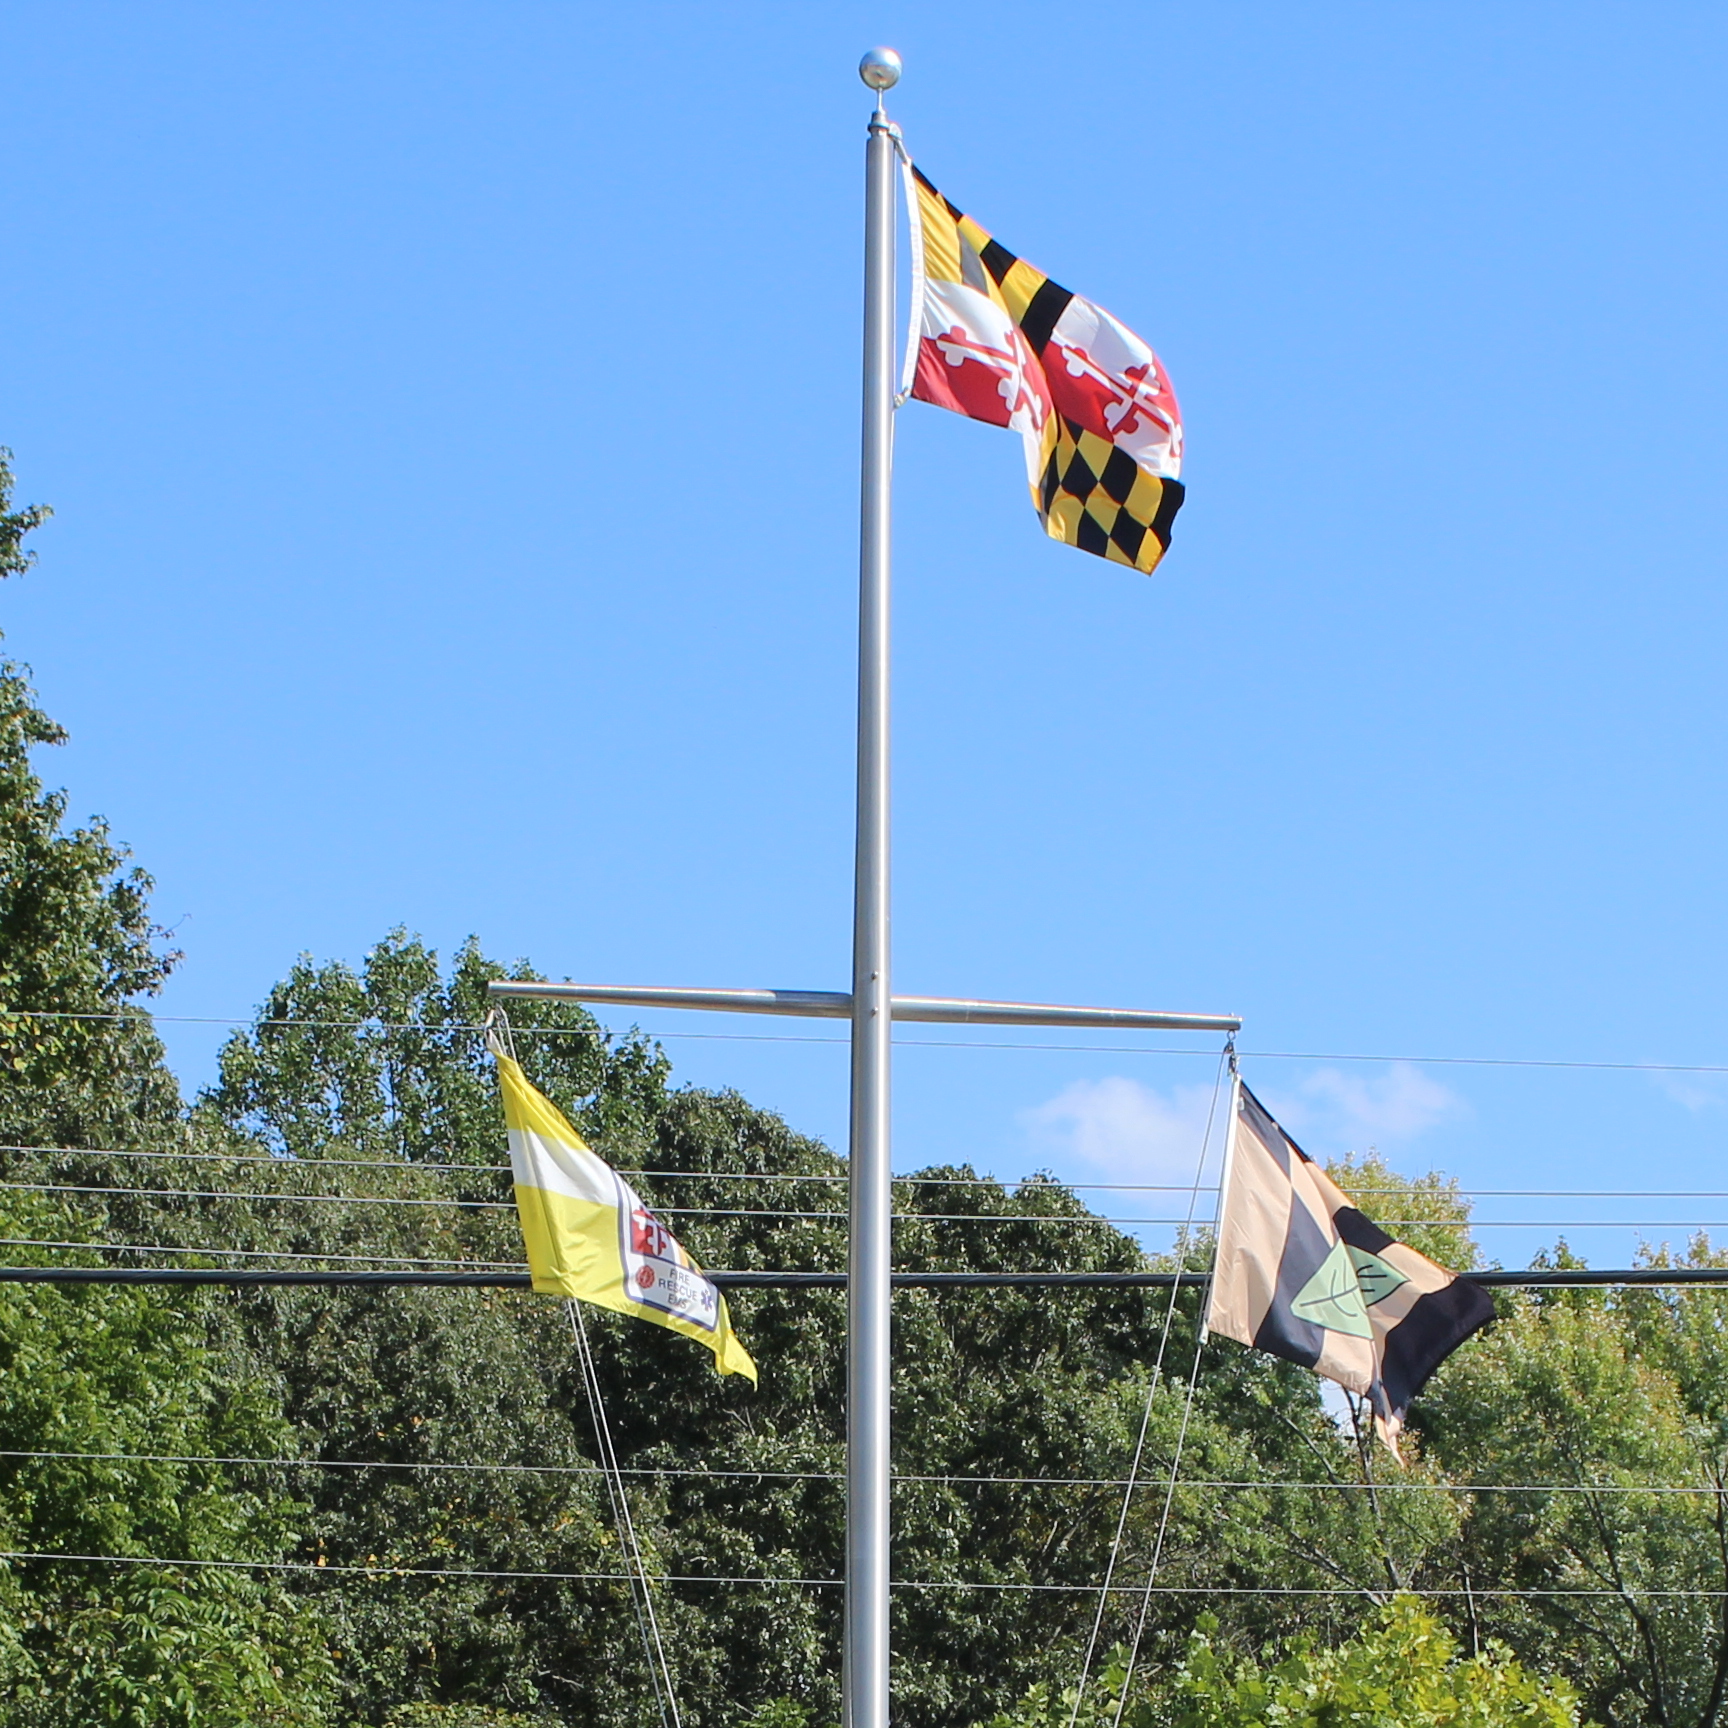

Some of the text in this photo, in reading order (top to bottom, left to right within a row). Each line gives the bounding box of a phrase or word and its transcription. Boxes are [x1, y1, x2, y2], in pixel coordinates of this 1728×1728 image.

[669, 1267, 691, 1284] FIRE
[658, 1277, 698, 1301] RESCUE
[668, 1294, 688, 1310] EMS
